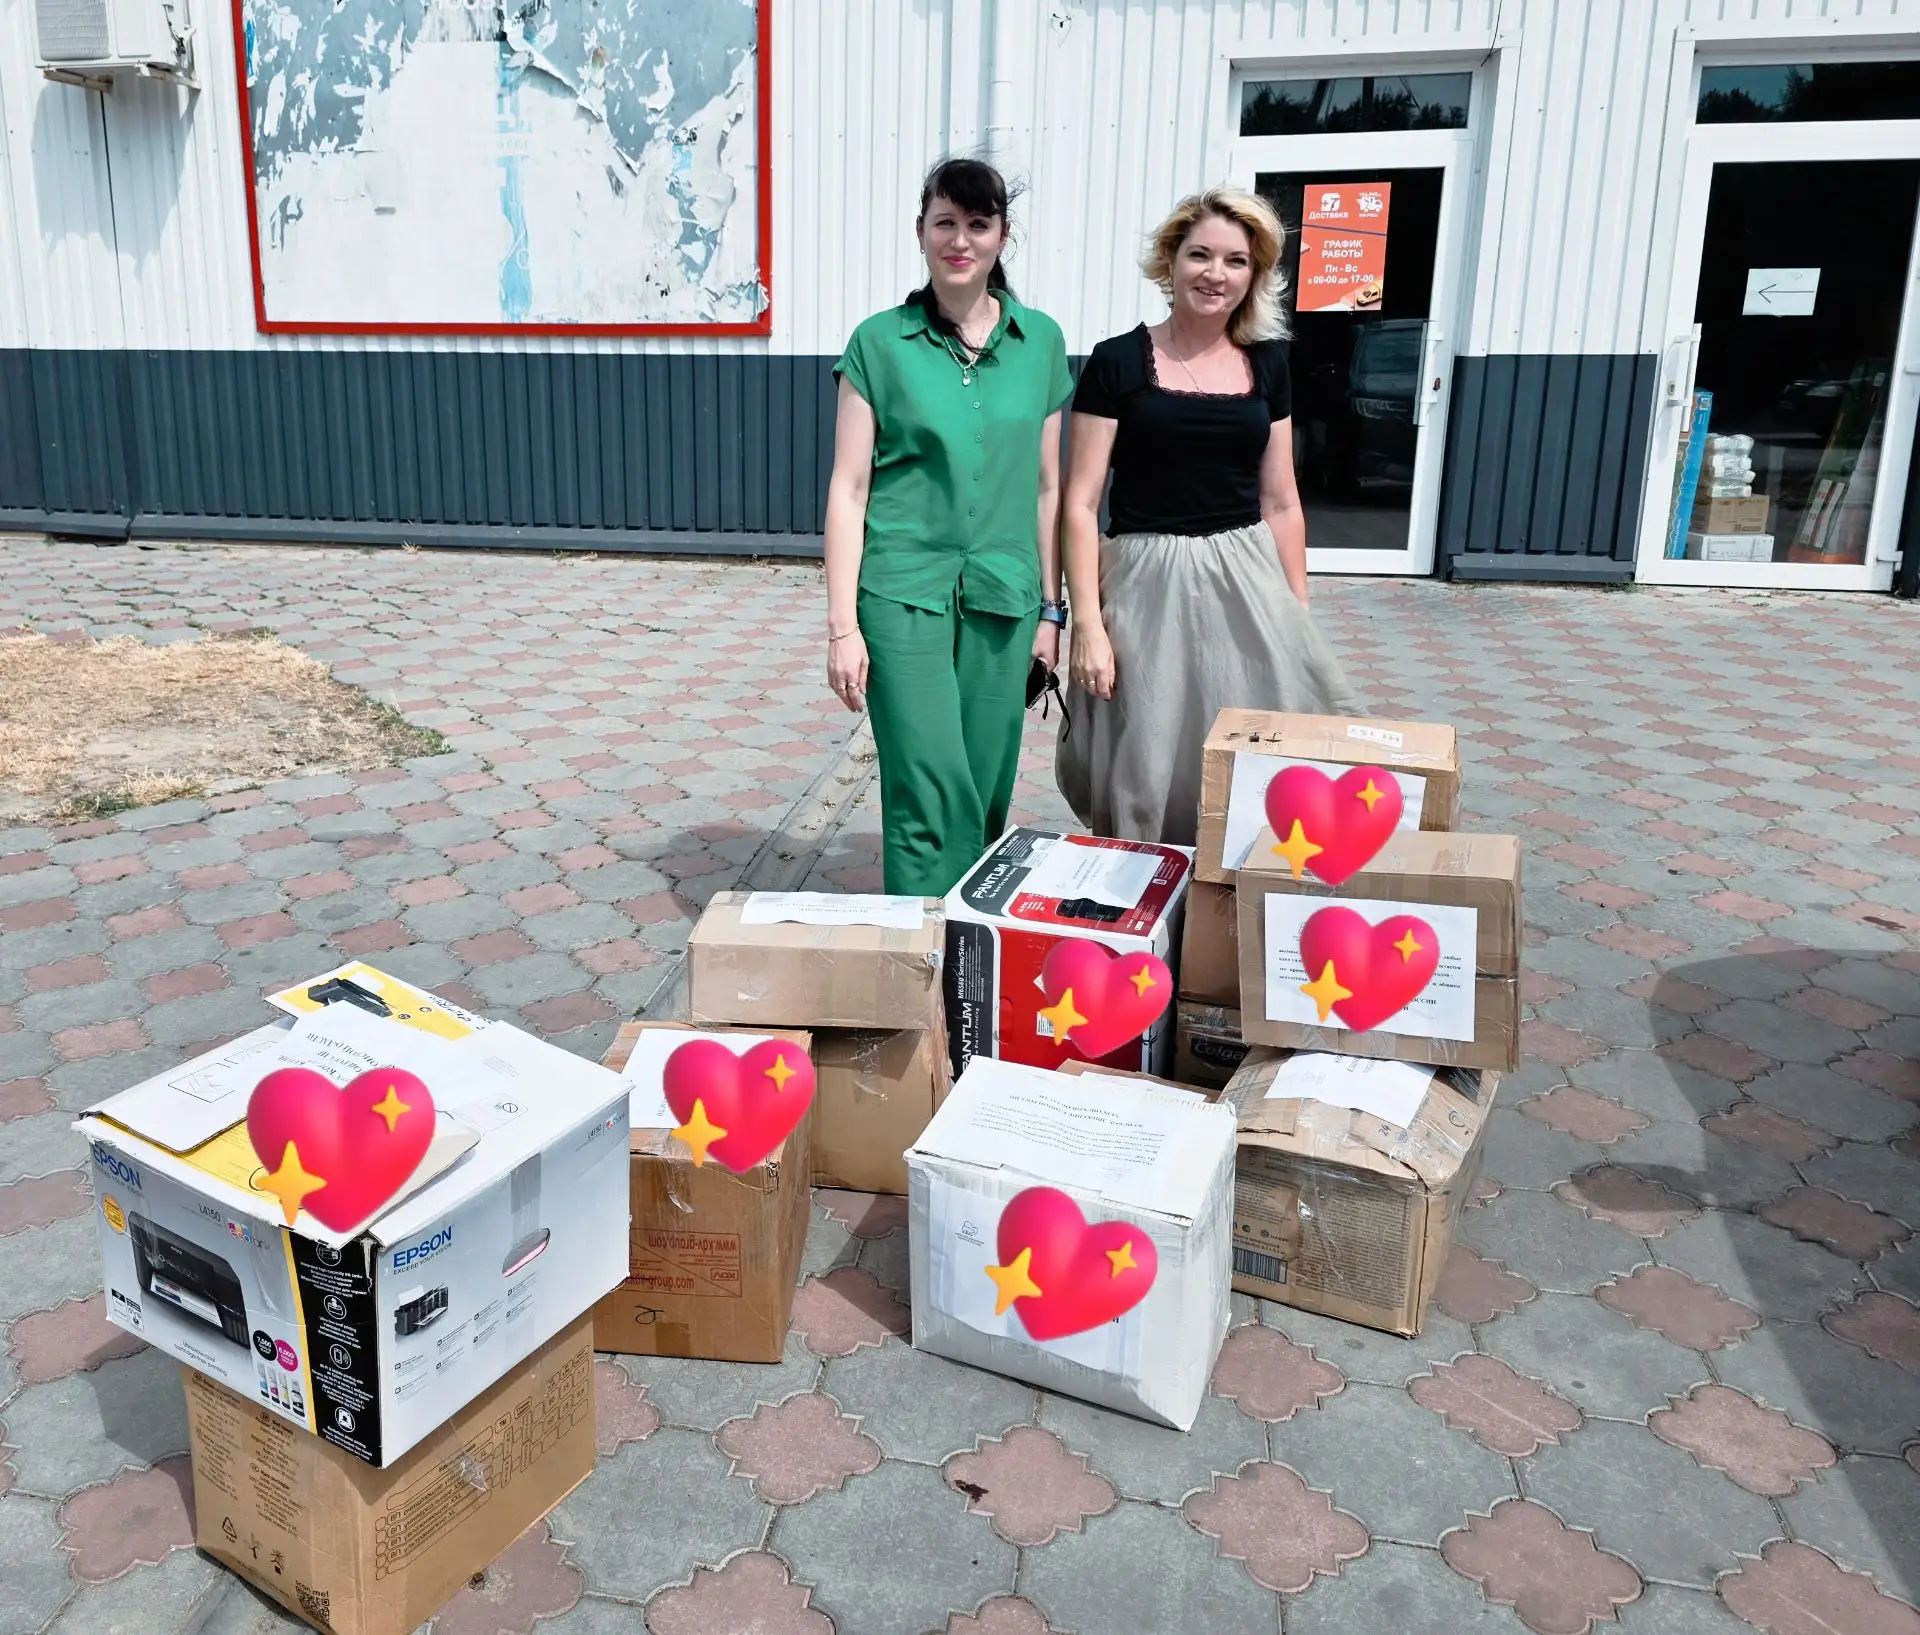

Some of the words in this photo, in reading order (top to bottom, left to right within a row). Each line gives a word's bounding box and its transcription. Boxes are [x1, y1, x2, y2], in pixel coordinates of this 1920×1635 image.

[1309, 211, 1349, 220] Доставка
[1323, 240, 1363, 248] ГРАФИК
[1321, 250, 1363, 258] РАБОТЫ
[1325, 264, 1338, 272] Пн
[1344, 264, 1358, 272] Вс
[1313, 276, 1337, 284] 09-00
[1351, 275, 1374, 283] 17-00
[971, 863, 1010, 899] PANTUM
[1195, 1042, 1244, 1061] Colga
[93, 1144, 142, 1191] EPSON
[198, 1203, 222, 1223] L4150
[393, 1226, 452, 1268] EPSON
[650, 1234, 737, 1254] www.kdv-group.com
[393, 1262, 419, 1275] EXCEED
[419, 1253, 434, 1266] YOUR
[625, 1274, 695, 1292] .kdv-group.com
[390, 1511, 401, 1522] ВП
[390, 1524, 401, 1535] ВП
[390, 1536, 401, 1547] ВП
[390, 1548, 401, 1559] ВП
[312, 1589, 329, 1598] me!
